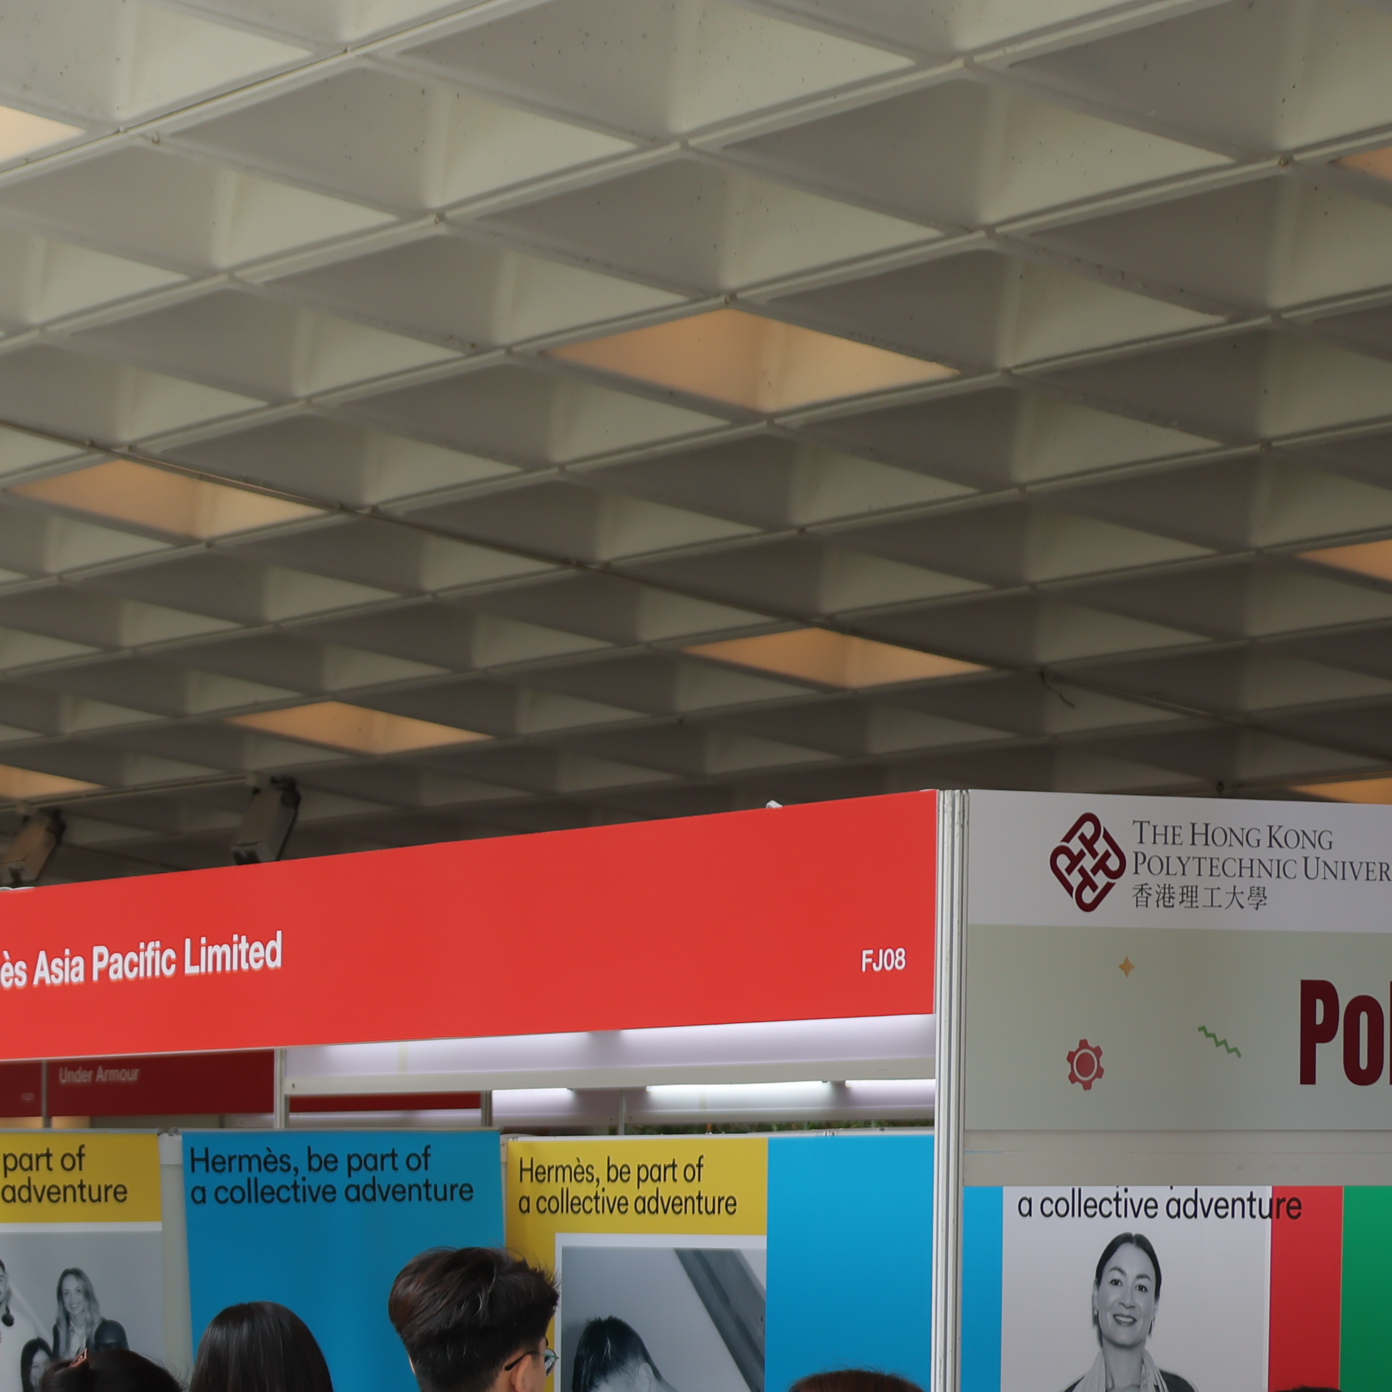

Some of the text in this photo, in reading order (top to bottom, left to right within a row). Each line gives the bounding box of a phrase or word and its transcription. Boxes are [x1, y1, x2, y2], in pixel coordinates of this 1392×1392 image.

[1132, 819, 1334, 851] THE HONG KONG
[1132, 850, 1297, 880] POLYTECHNIC
[1132, 883, 1267, 911] 香港理工大學
[33, 947, 84, 985] Asia
[92, 940, 176, 981] Pacific
[185, 930, 282, 975] Limited
[861, 947, 906, 973] FJ08
[1300, 979, 1392, 1086] Po
[59, 1065, 139, 1083] Under Armour
[4, 1149, 53, 1178] part
[60, 1144, 86, 1171] of
[191, 1144, 431, 1178] Hermès, be part of
[519, 1155, 704, 1188] Hermès, be part of
[0, 1176, 128, 1204] adventure
[191, 1176, 474, 1205] a collective adventure
[518, 1187, 737, 1216] a collective adventure
[1017, 1187, 1303, 1220] a collective adventure
